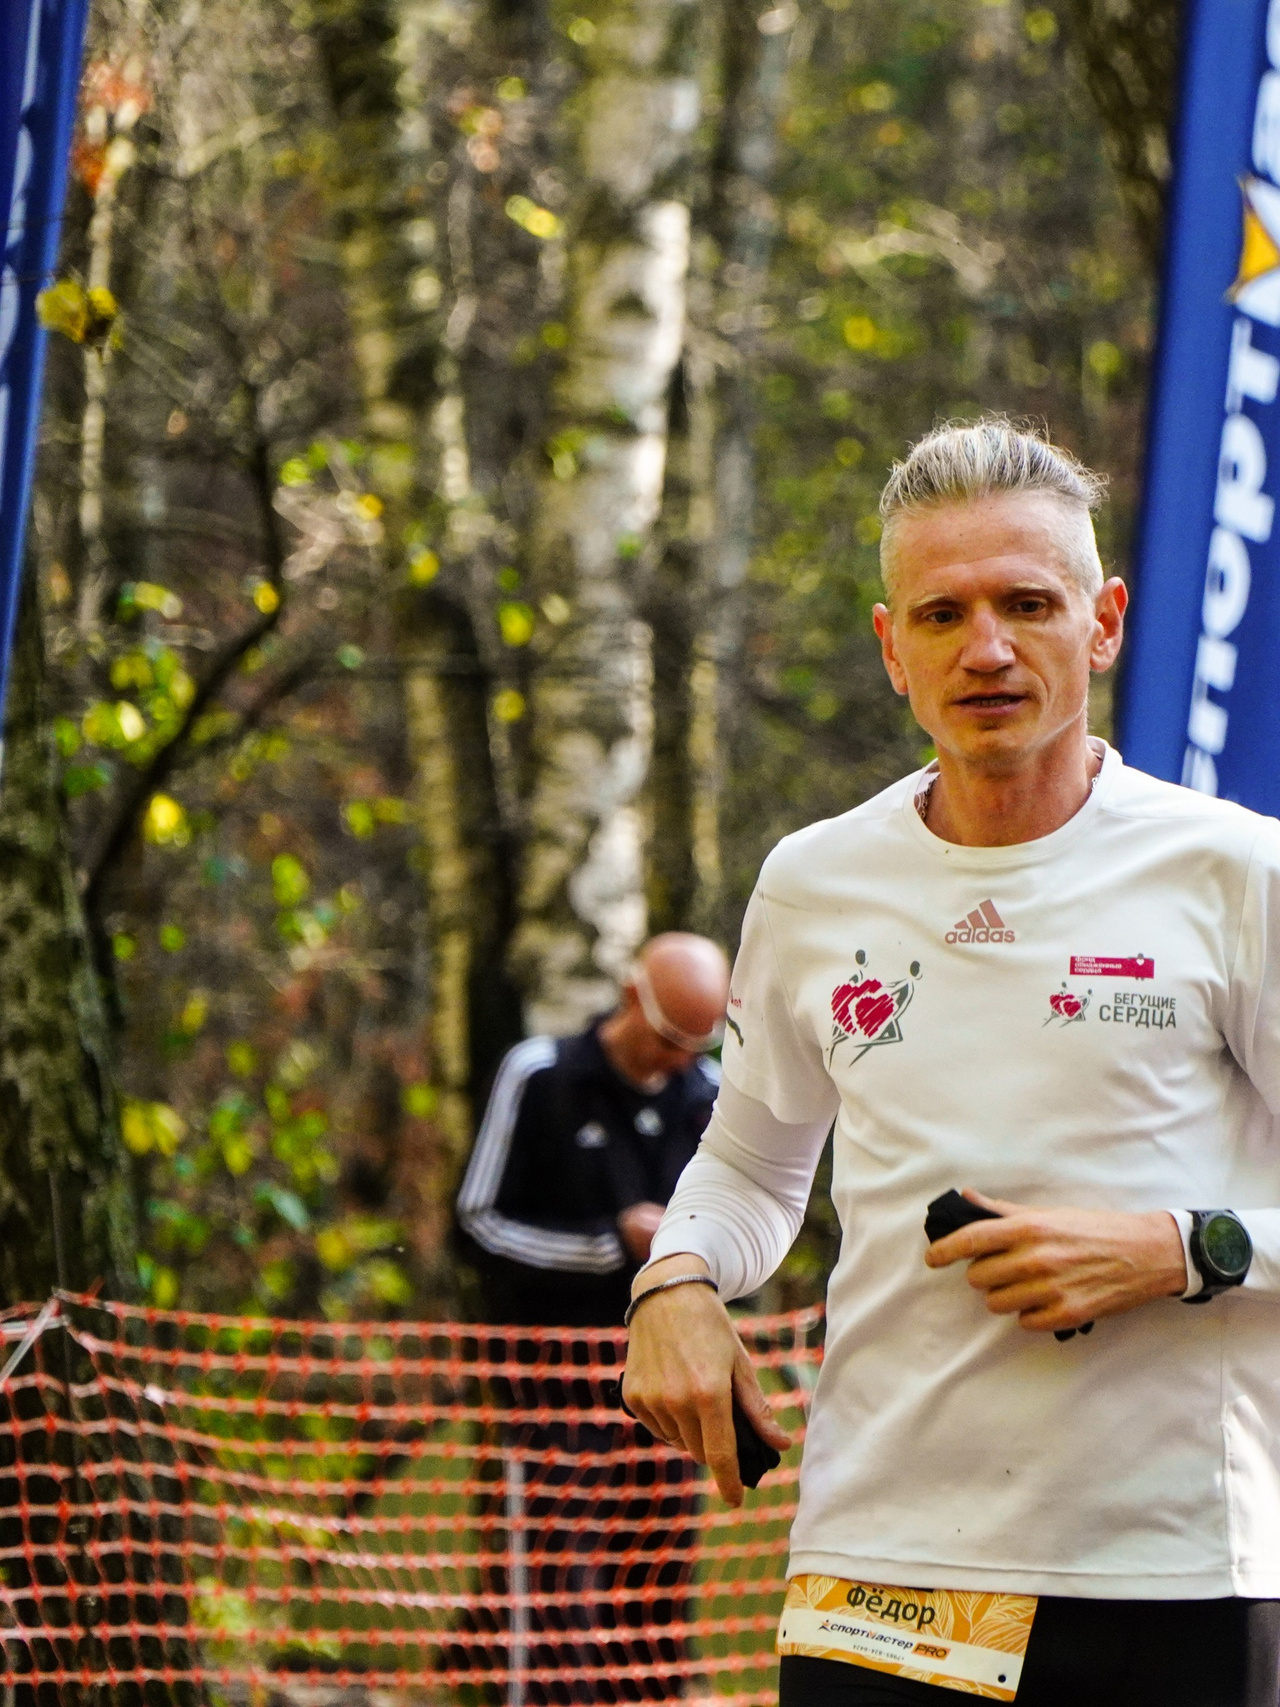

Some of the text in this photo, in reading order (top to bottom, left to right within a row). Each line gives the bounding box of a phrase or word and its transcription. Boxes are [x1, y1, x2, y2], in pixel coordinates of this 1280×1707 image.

[944, 926, 1016, 944] adidas
[1114, 992, 1176, 1010] БЕГУЩИЕ
[1099, 1005, 1177, 1030] СЕРДЦА
[846, 1585, 936, 1630] Фёдор
[915, 1643, 948, 1659] PRO
